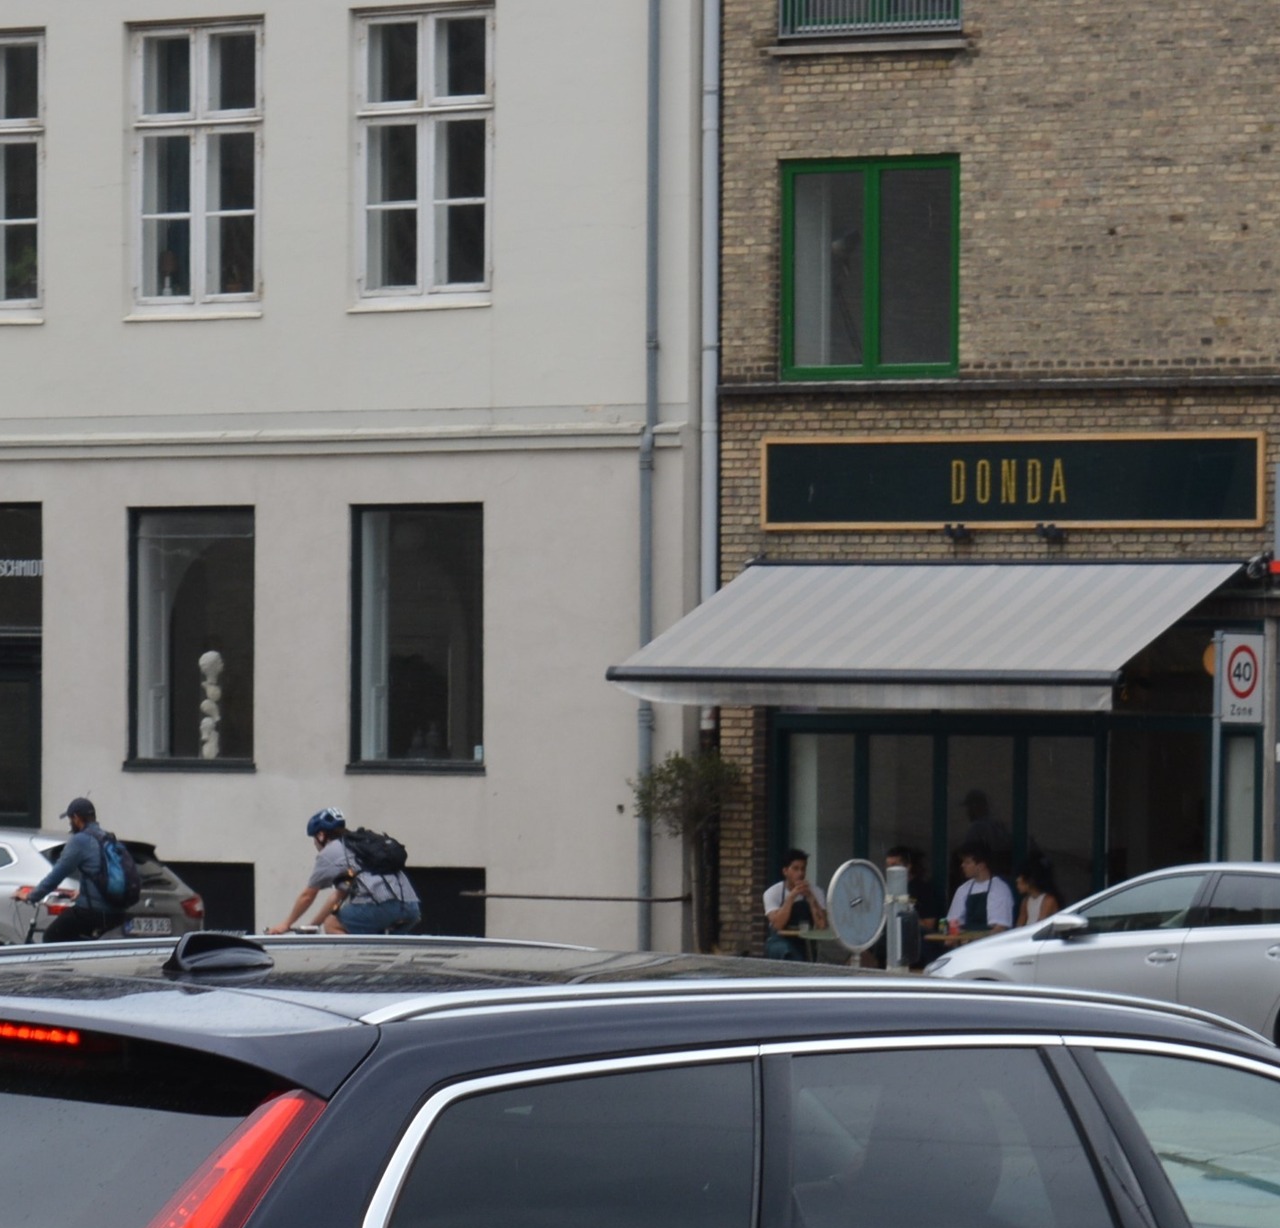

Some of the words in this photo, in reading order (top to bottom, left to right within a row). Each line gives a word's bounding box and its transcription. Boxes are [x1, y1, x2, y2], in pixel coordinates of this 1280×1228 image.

[951, 458, 1067, 504] DONDA
[1232, 661, 1252, 682] 40
[1230, 703, 1253, 717] Zone
